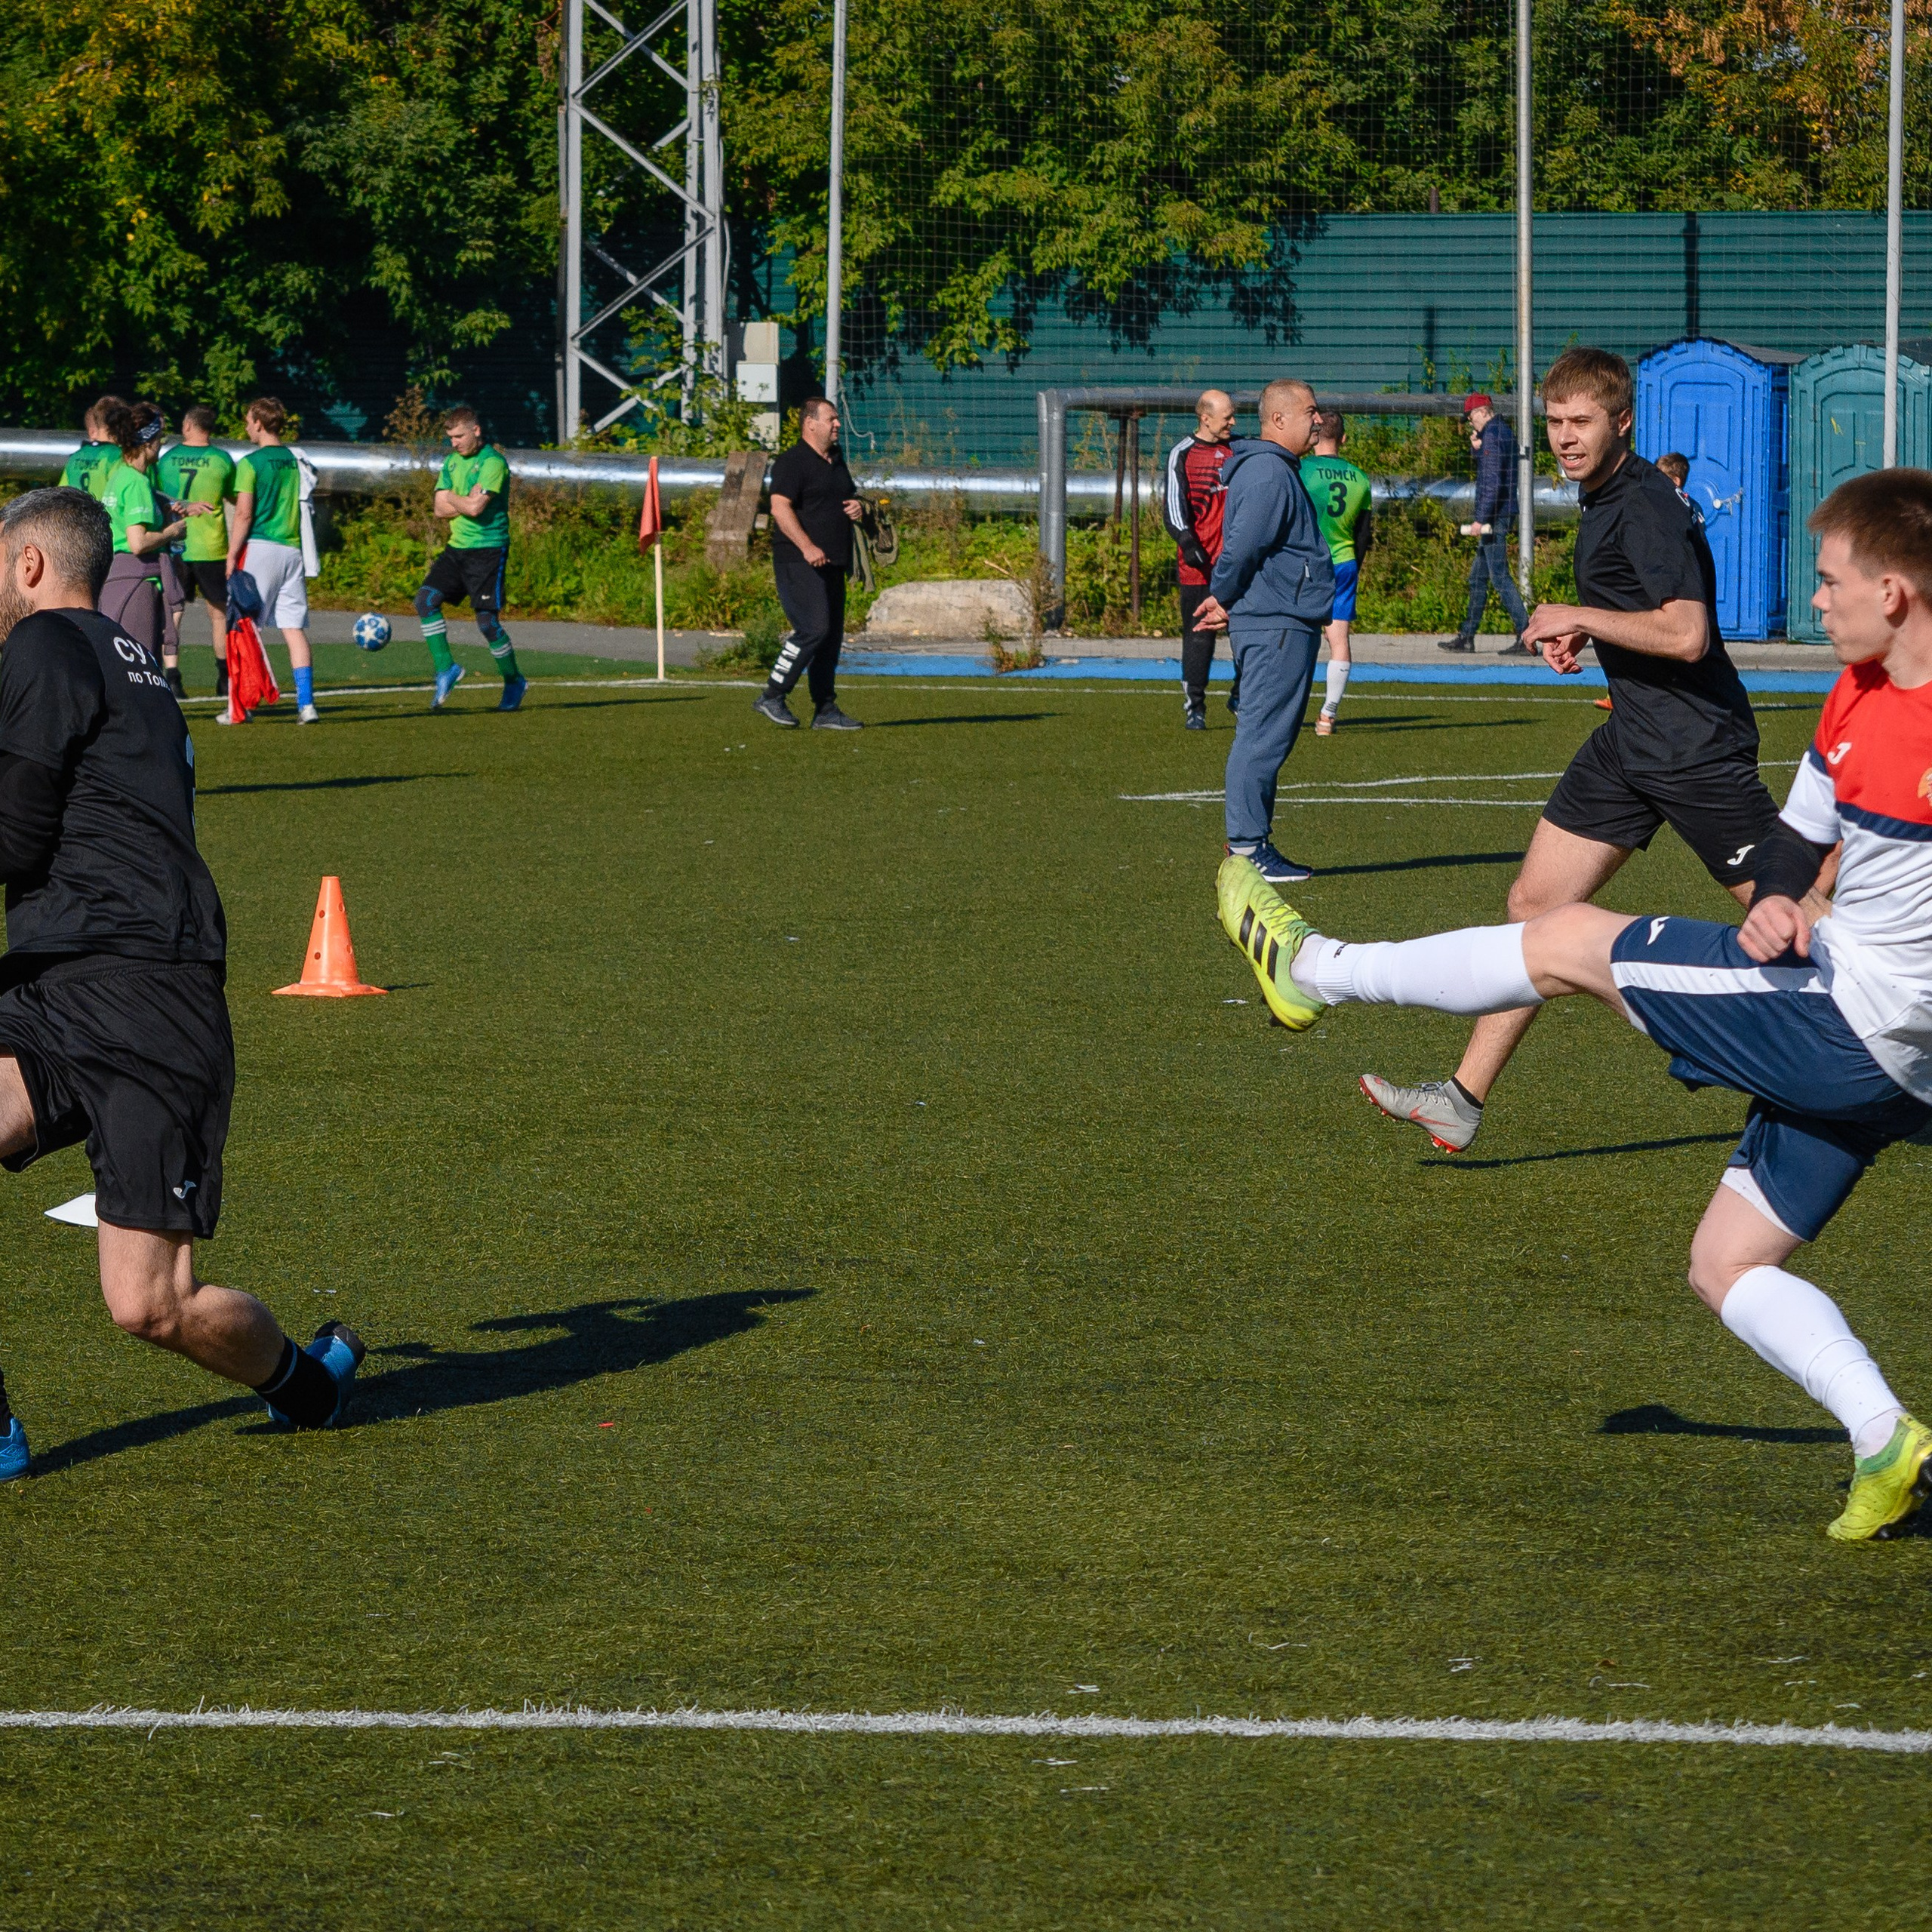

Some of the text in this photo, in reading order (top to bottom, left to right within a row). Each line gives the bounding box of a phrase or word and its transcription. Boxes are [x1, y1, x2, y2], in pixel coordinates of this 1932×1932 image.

[180, 468, 197, 500] 7
[1327, 481, 1347, 518] 3
[128, 671, 171, 691] по Том
